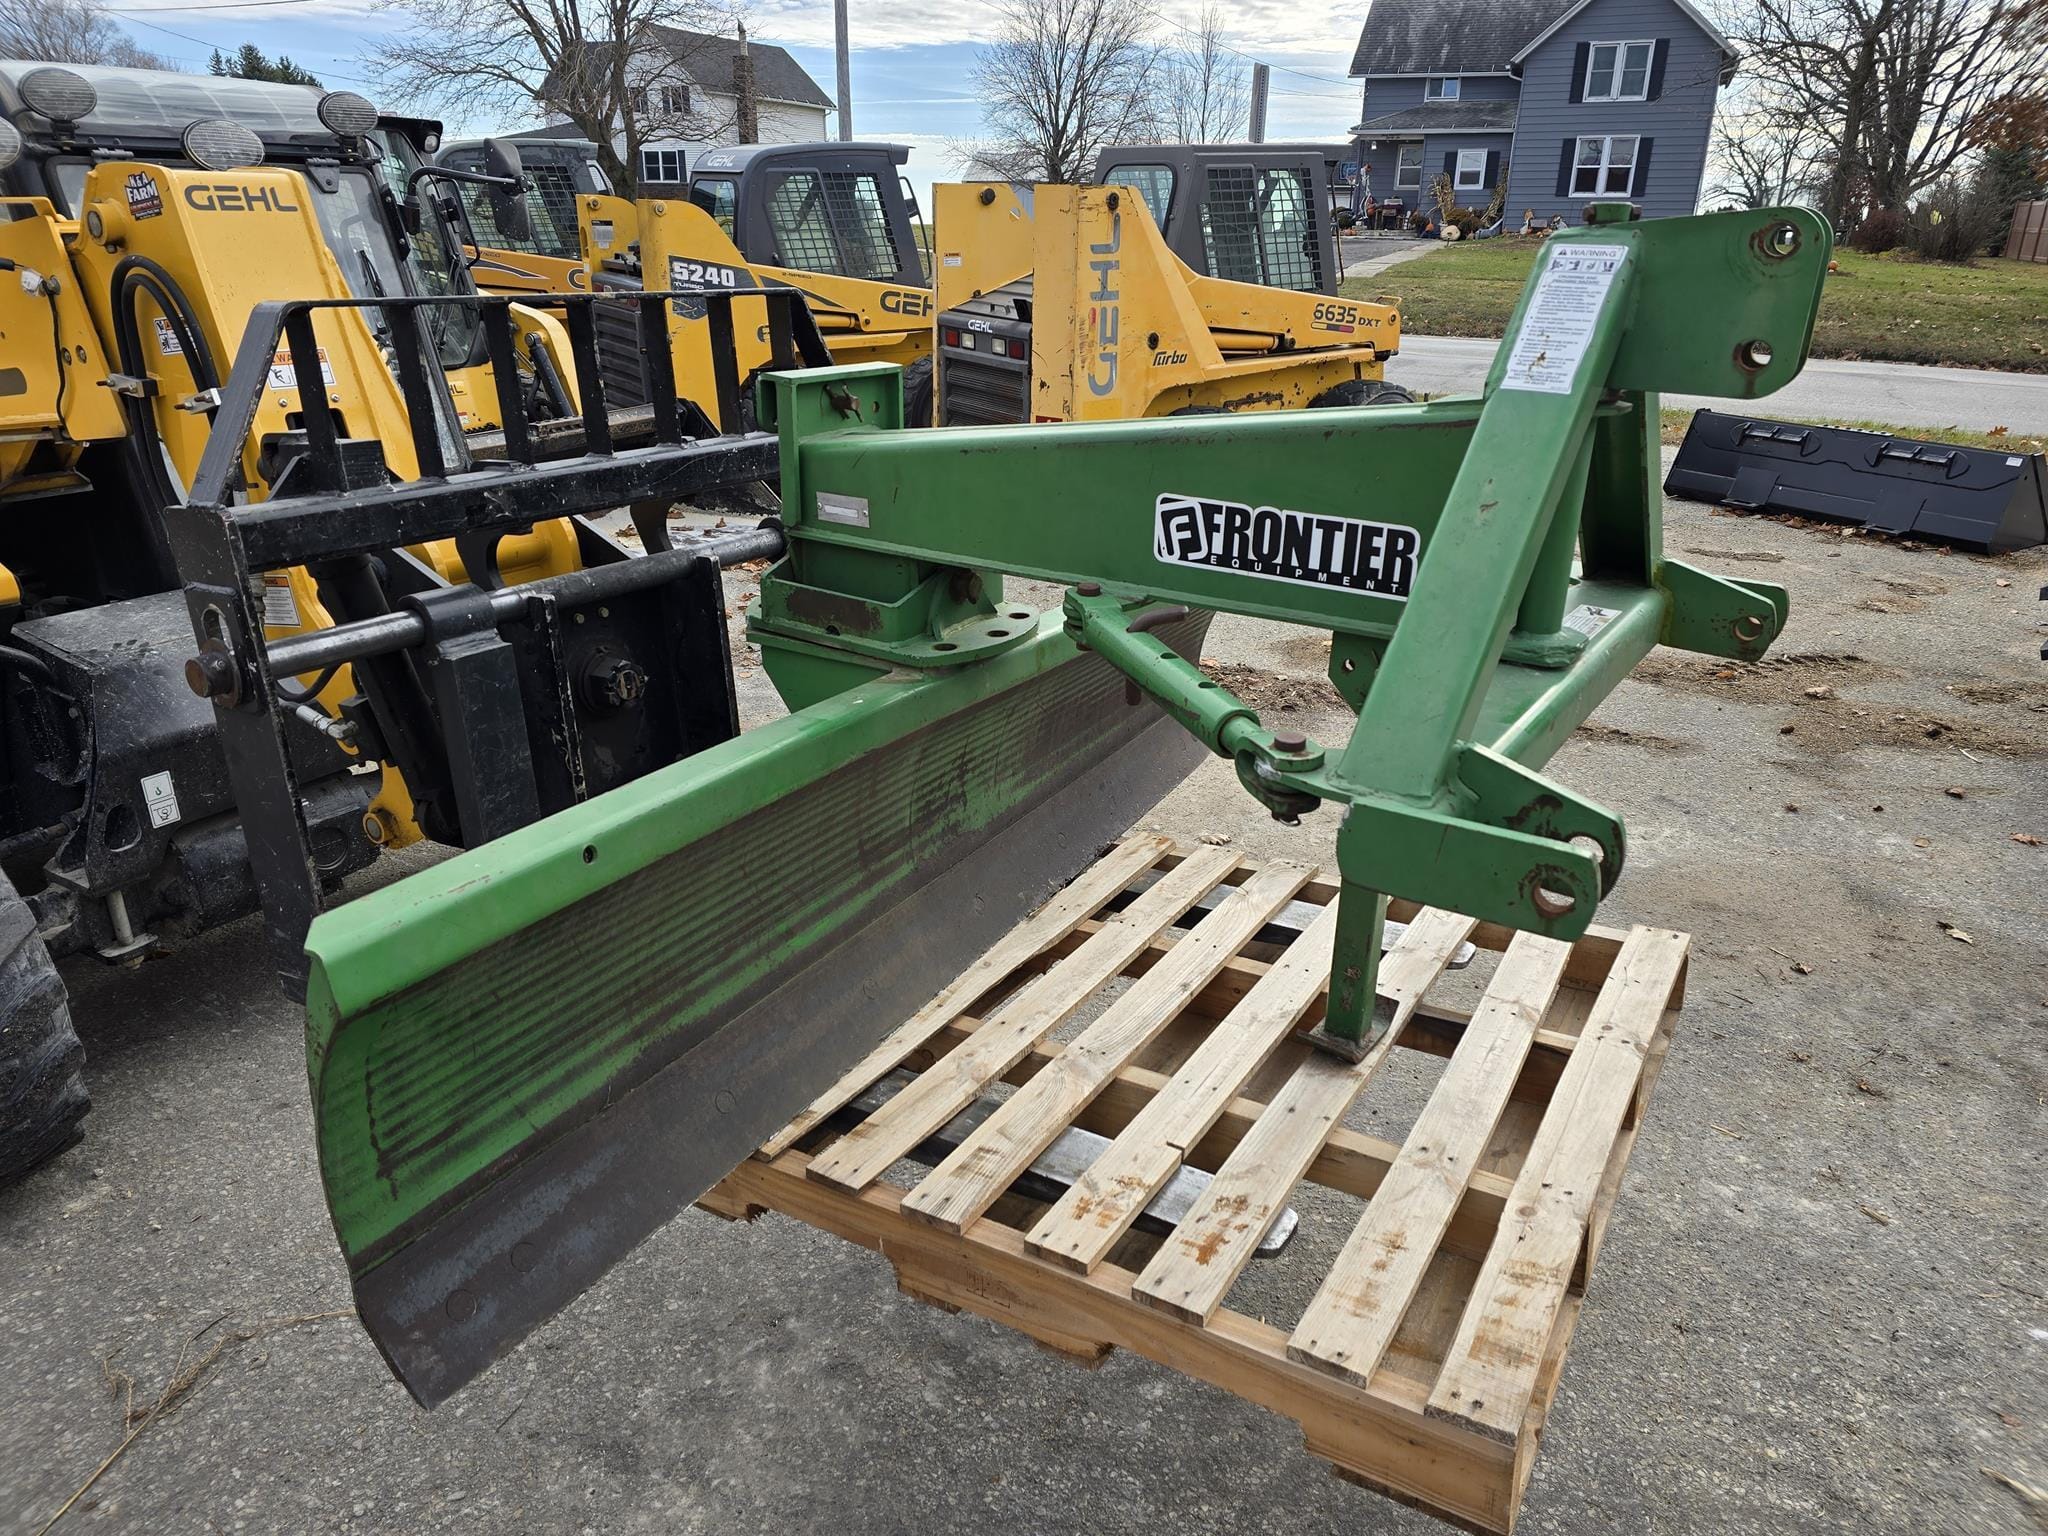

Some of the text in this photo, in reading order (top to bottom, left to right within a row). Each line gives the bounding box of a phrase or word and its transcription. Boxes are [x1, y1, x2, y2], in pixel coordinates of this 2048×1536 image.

[126, 179, 158, 203] FARM
[184, 184, 298, 212] GEHL
[1570, 249, 1618, 258] WARNING
[672, 261, 736, 288] 5240
[880, 290, 934, 317] GEH
[1088, 212, 1121, 396] GEHL
[1313, 303, 1358, 324] 6635
[968, 319, 993, 333] GEHL
[1358, 316, 1382, 328] DXT
[1153, 350, 1188, 367] Turbo
[1200, 502, 1417, 590] FRONTIER
[1210, 555, 1399, 593] EQUIPMENT
